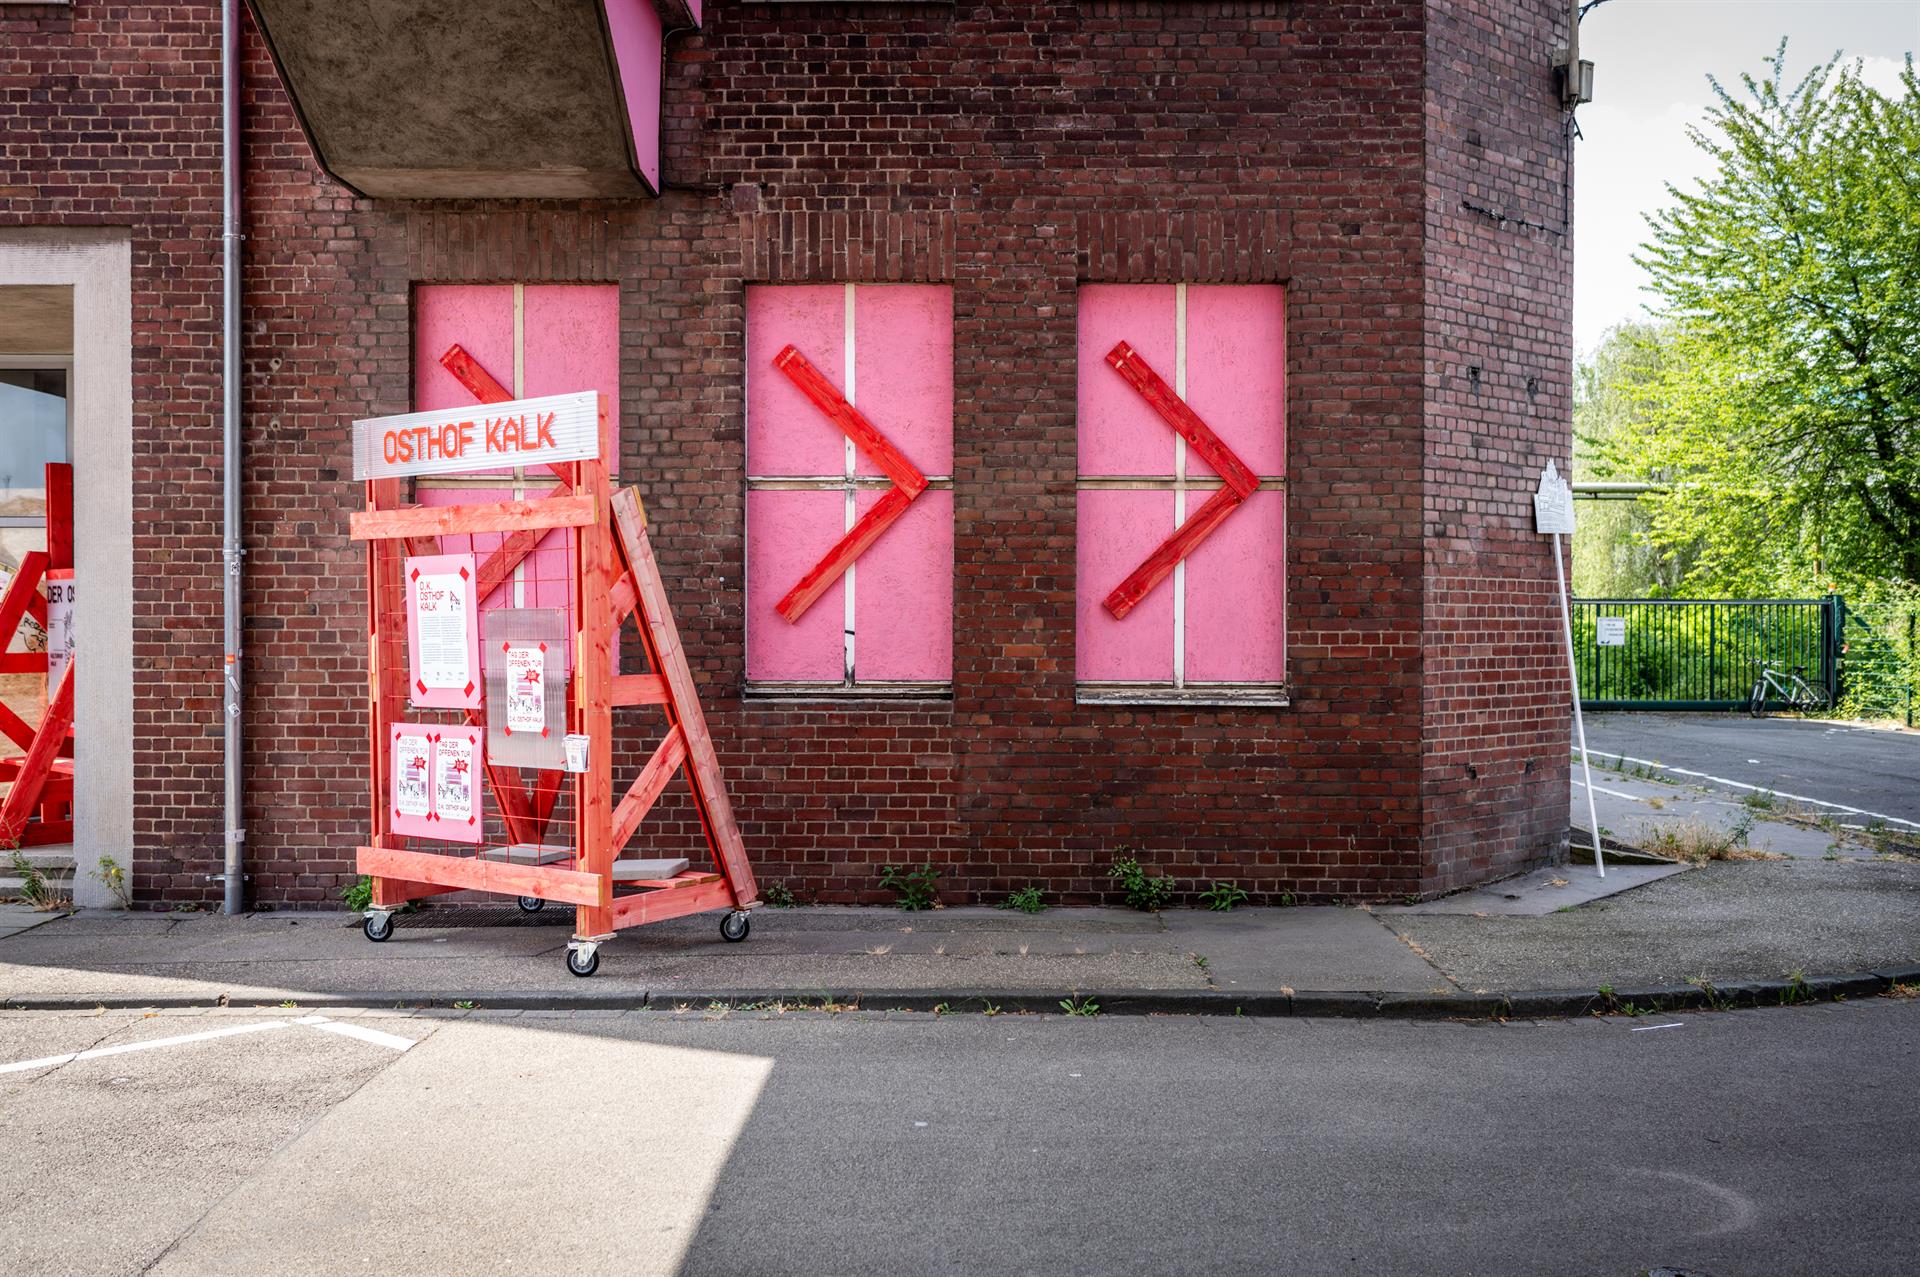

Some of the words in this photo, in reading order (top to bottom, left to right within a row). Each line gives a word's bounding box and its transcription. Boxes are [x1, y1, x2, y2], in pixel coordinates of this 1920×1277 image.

[383, 421, 475, 464] OSTHOF
[485, 412, 557, 453] KALK
[47, 585, 63, 604] DER
[419, 591, 445, 601] OSTHOF
[420, 602, 437, 611] KALK
